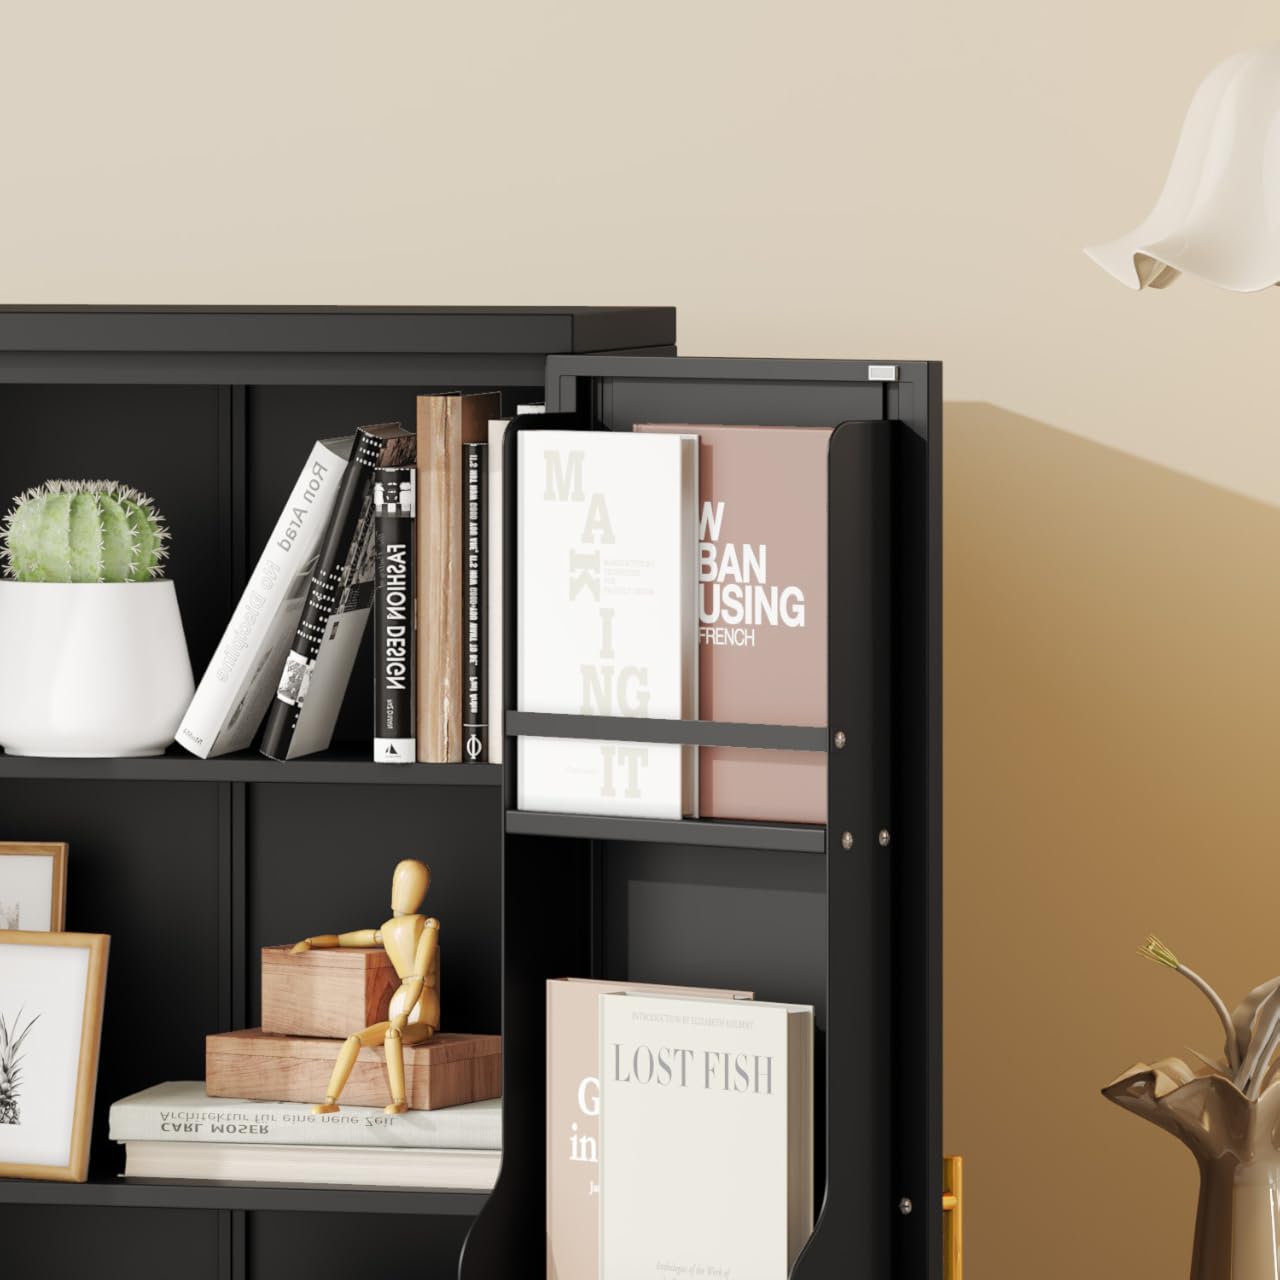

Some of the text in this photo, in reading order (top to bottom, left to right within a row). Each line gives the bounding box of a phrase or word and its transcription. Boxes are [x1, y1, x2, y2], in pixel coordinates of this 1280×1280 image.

[543, 449, 585, 502] M
[581, 492, 615, 544] A
[699, 583, 805, 628] USING
[579, 663, 651, 718] NG
[599, 744, 649, 799] IT
[612, 1042, 775, 1096] LOST FISH
